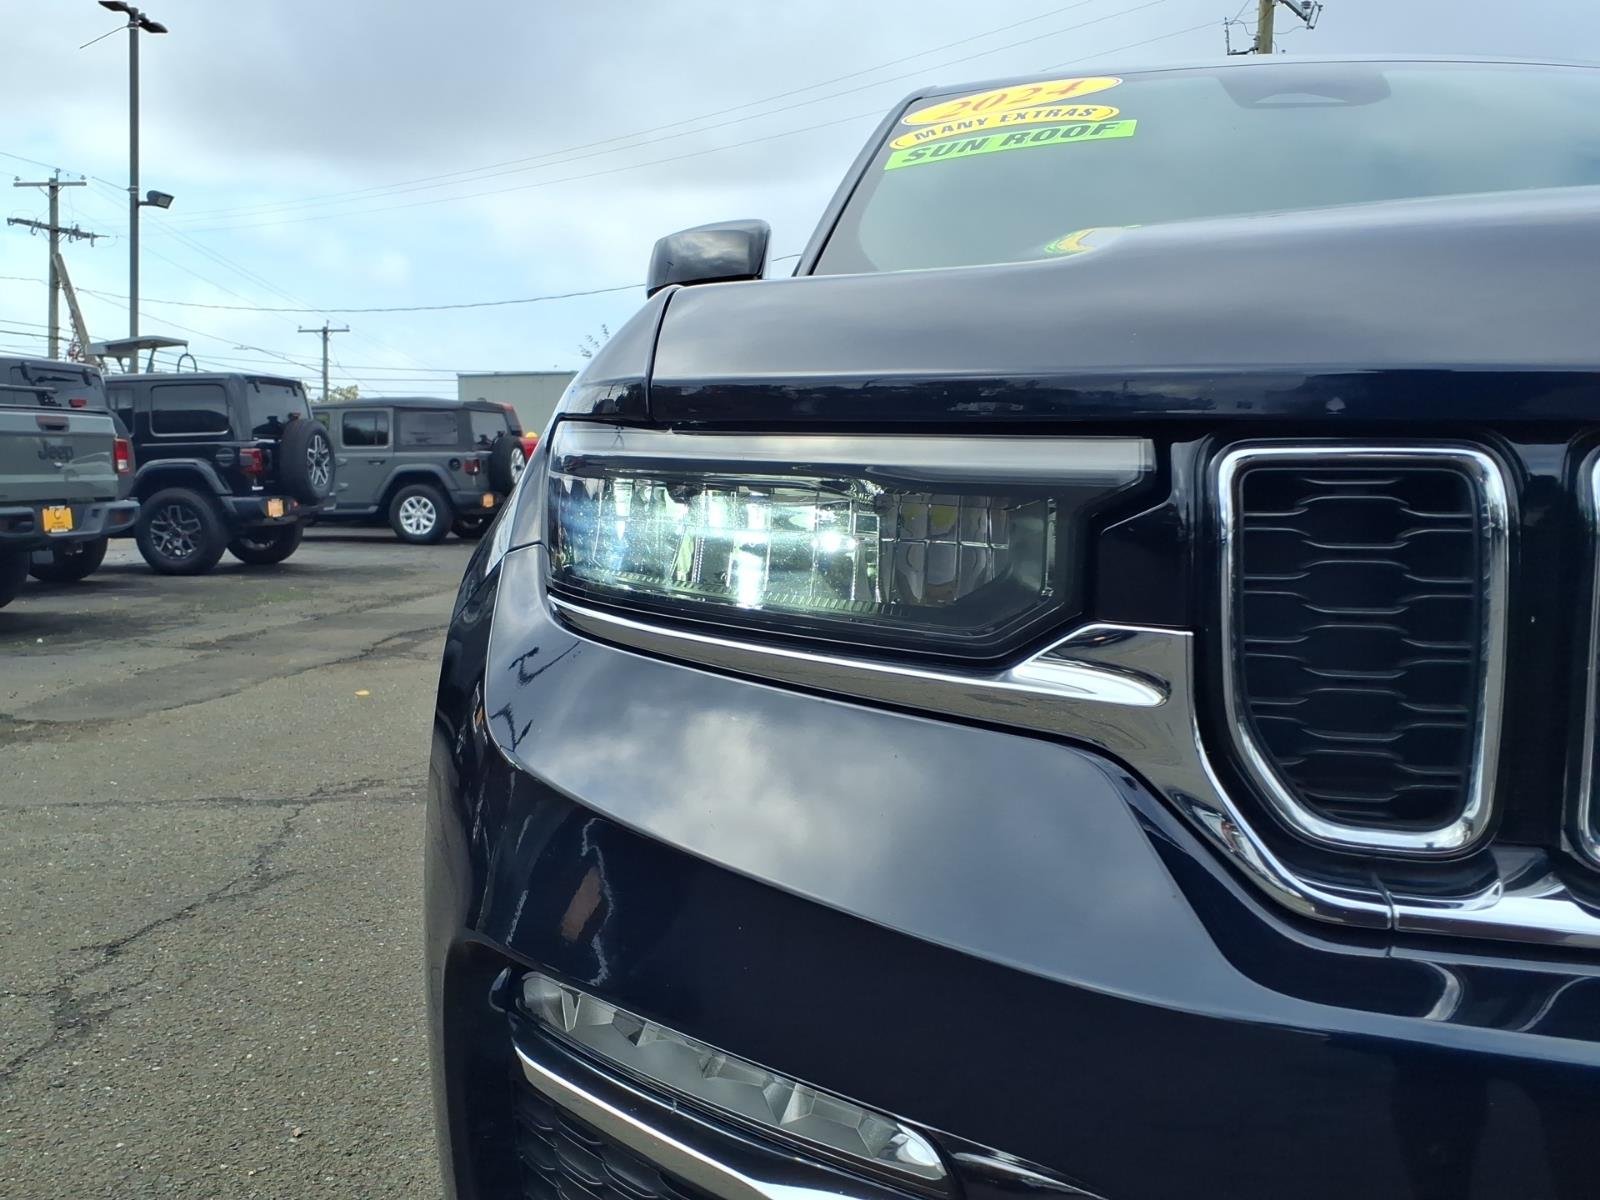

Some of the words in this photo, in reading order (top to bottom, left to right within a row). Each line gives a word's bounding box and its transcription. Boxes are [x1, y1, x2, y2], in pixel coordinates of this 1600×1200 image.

[935, 79, 1086, 120] 2024
[902, 137, 990, 162] SUN
[1000, 122, 1119, 146] ROOF
[914, 117, 989, 141] MANY
[999, 107, 1097, 123] EXTRAS
[38, 439, 74, 463] Jeep
